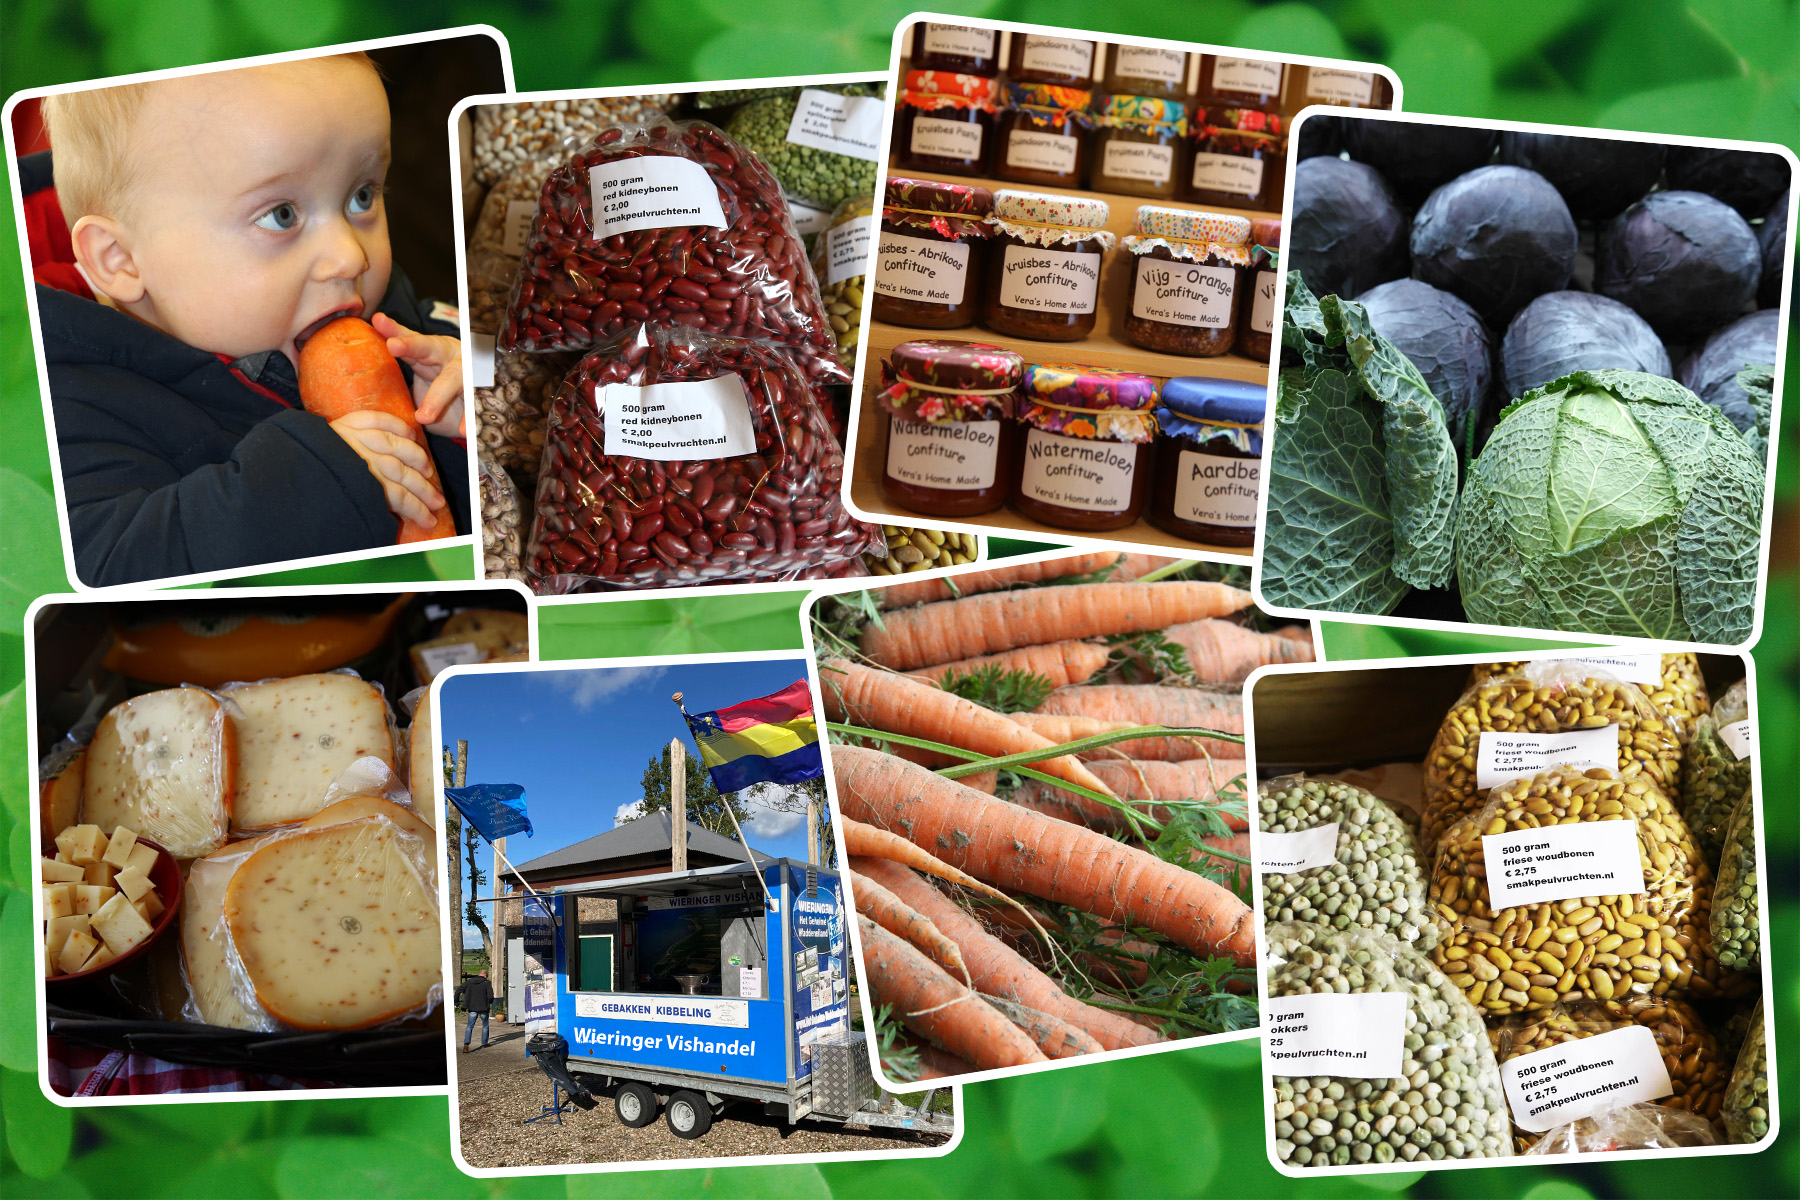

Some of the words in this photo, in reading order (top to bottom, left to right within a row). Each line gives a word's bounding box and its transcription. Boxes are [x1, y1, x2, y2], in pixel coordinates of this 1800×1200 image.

[602, 179, 618, 189] 500
[620, 176, 644, 187] gram
[603, 191, 617, 201] red
[619, 185, 679, 197] kidneybonen
[604, 205, 609, 213] €
[611, 201, 629, 212] 2,00
[604, 207, 701, 225] smakpeulvruchten.nl
[878, 243, 908, 255] uisbes
[918, 247, 964, 272] Abrikoos
[884, 260, 937, 279] Confiture
[1006, 258, 1051, 274] Kruisbes
[1061, 260, 1097, 281] Abrikoos
[875, 280, 897, 292] Vera's
[899, 285, 924, 297] Home
[927, 288, 950, 300] Made
[1025, 273, 1078, 291] Confiture
[1142, 268, 1170, 287] Vijg
[1186, 269, 1232, 297] Orange
[1014, 295, 1041, 307] Vera's
[1044, 299, 1067, 309] Home
[1070, 300, 1088, 310] Made
[1156, 286, 1209, 305] Confiture
[1146, 306, 1170, 318] Vera's
[1173, 311, 1197, 322] Home
[1200, 314, 1220, 324] Made
[621, 404, 640, 413] 500
[642, 403, 666, 415] gram
[641, 413, 703, 426] kidneybonen
[621, 435, 727, 449] smakpeulvruchten.nl
[630, 429, 652, 438] 2,00
[893, 420, 995, 448] Watermeloen
[907, 442, 966, 464] Confiture
[1029, 440, 1132, 476] Watermeloen
[897, 466, 922, 480] Vera's
[925, 472, 952, 484] Home
[956, 475, 980, 485] Made
[1045, 463, 1104, 485] Confiture
[1191, 461, 1260, 481] Aardbe
[1034, 485, 1060, 500] Vera's
[1064, 492, 1090, 505] Home
[1094, 497, 1118, 506] Made
[1192, 506, 1221, 520] Vera's
[1225, 512, 1250, 521] Home
[1524, 745, 1577, 755] woudbonen
[1502, 844, 1521, 855] 500
[1524, 842, 1550, 852] gram
[1503, 856, 1533, 866] friese
[1535, 850, 1595, 862] woudbonen
[1514, 866, 1537, 877] 2,75
[1506, 872, 1614, 890] smakpeulvruchten.nl
[669, 895, 721, 907] WIERINGER
[601, 1003, 651, 1015] GEBAKKEN
[656, 1006, 712, 1018] KIBBELING
[1276, 1012, 1305, 1023] gram
[1271, 1024, 1309, 1034] okkers
[573, 1027, 663, 1051] Wieringer
[666, 1034, 756, 1057] Vishandel
[1270, 1038, 1284, 1046] 25
[1270, 1048, 1367, 1060] kpeulvruchten.nl
[1517, 1066, 1537, 1079] 500
[1539, 1058, 1567, 1073] gram
[1520, 1076, 1552, 1091] friese
[1553, 1059, 1614, 1080] woudbonen
[1525, 1094, 1533, 1103] €
[1534, 1085, 1558, 1100] 2,75
[1529, 1076, 1640, 1117] smakpeulvruchten.nl
